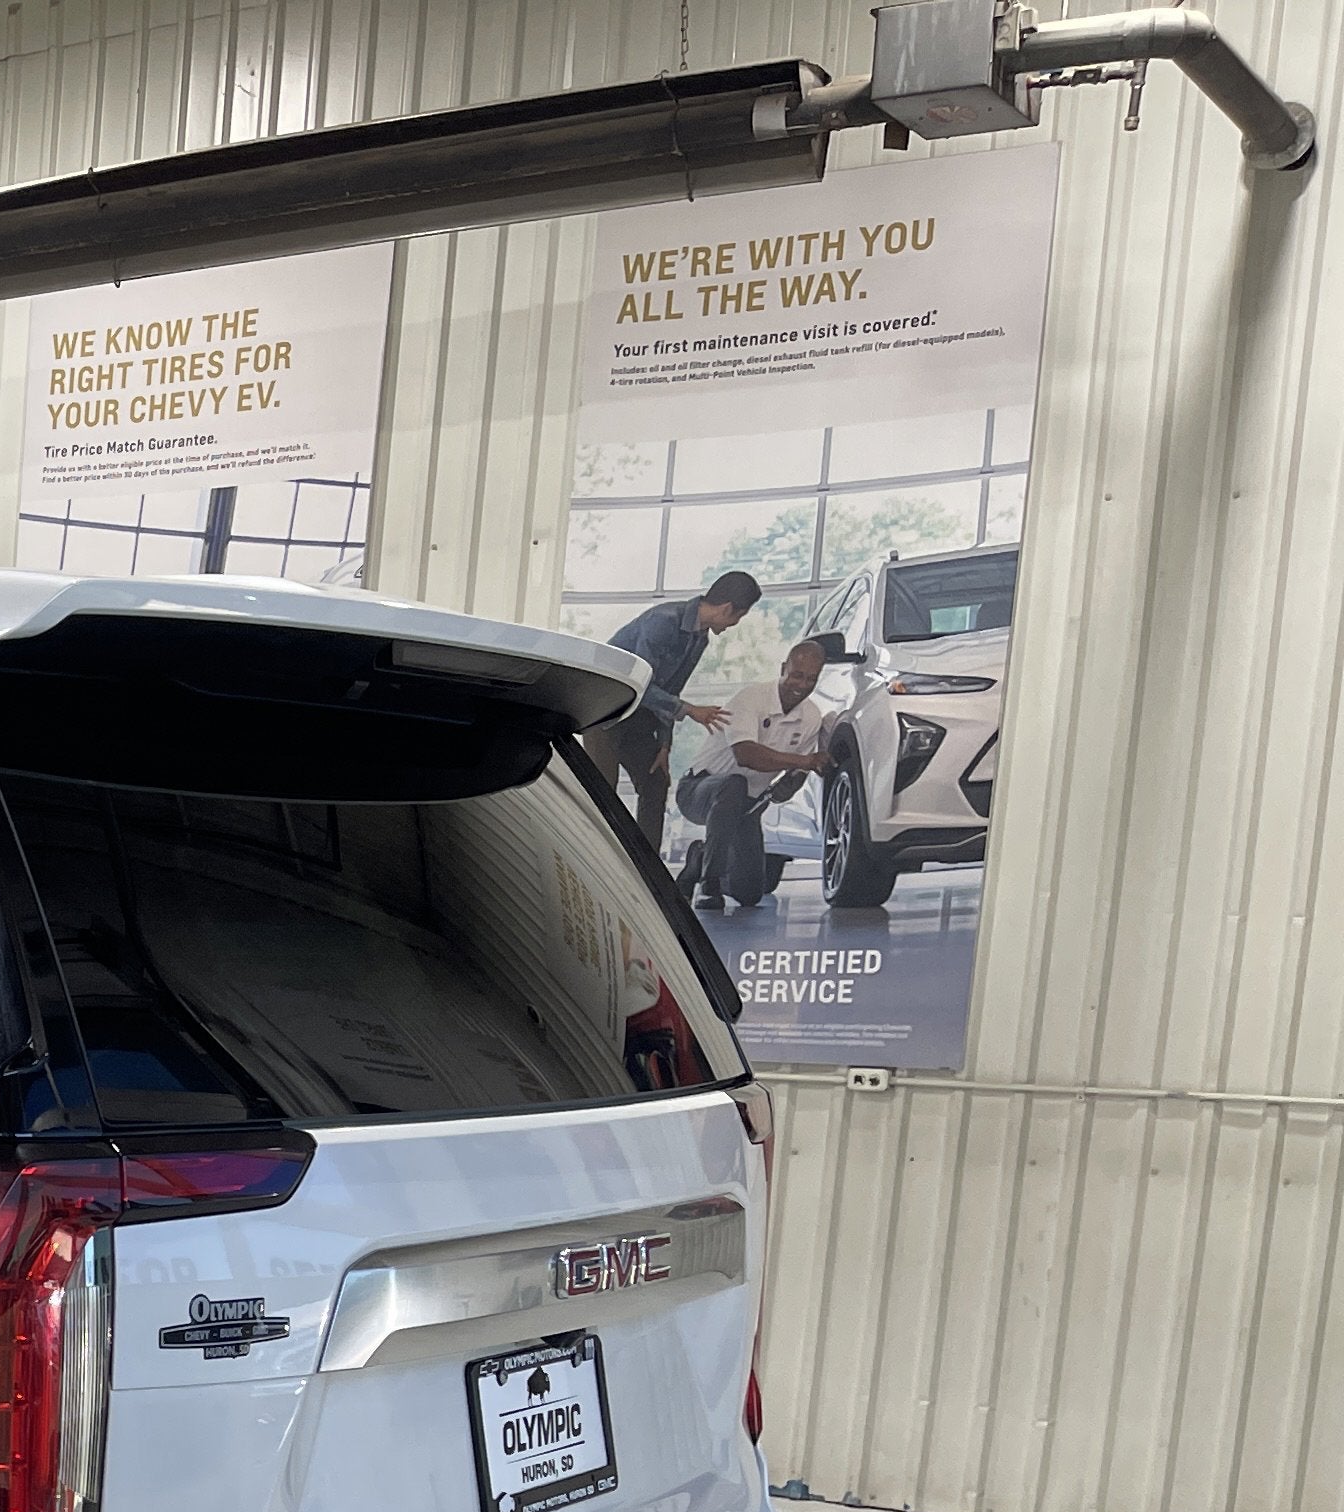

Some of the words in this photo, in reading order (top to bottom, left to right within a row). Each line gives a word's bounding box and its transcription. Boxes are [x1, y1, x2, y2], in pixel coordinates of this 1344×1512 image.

[623, 242, 736, 284] WE'RE
[748, 229, 845, 271] WITH
[859, 217, 936, 257] YOU
[616, 290, 684, 325] ALL
[696, 280, 767, 317] THE
[779, 268, 868, 308] WAY.
[53, 330, 96, 360] WE
[105, 318, 193, 355] KNOW
[202, 308, 259, 342] THE
[614, 343, 649, 358] Your
[653, 339, 688, 355] first
[693, 330, 798, 352] maintenance
[803, 323, 839, 340] visit
[843, 321, 857, 336] is
[49, 361, 134, 395] RIGHT
[142, 350, 224, 385] TIRES
[234, 341, 292, 375] FOR
[611, 366, 648, 375] Includes:
[649, 364, 660, 373] oil
[661, 363, 676, 372] and
[677, 362, 688, 370] oil
[689, 360, 710, 369] filter
[712, 358, 745, 368] change,
[746, 354, 772, 364] diesel
[773, 351, 806, 361] exhaust
[809, 348, 829, 358] fluid
[830, 345, 850, 355] tank
[893, 331, 965, 348] diesel-equipped
[671, 373, 687, 382] and
[688, 370, 735, 381] Multi-Point
[736, 366, 767, 376] Vehicle
[48, 399, 119, 430] YOUR
[129, 386, 228, 423] CHEVY
[236, 380, 280, 411] EV.
[44, 445, 67, 458] Tire
[71, 442, 103, 456] Price
[106, 439, 144, 454] Match
[148, 434, 218, 450] Guarantee.
[78, 464, 92, 472] with
[98, 462, 119, 470] better
[145, 459, 162, 467] price
[186, 454, 201, 462] time
[202, 453, 209, 461] of
[246, 448, 259, 456] and
[278, 443, 301, 453] match
[84, 474, 101, 482] price
[102, 472, 123, 480] within
[133, 470, 149, 478] days
[237, 459, 262, 468] refund
[739, 950, 882, 975] CERTIFIED
[737, 979, 855, 1004] SERVICE
[557, 1232, 671, 1299] GMC
[190, 1295, 264, 1322] OLYMPIC
[502, 1403, 582, 1455] OLYMPIC
[521, 1458, 558, 1483] HURON,
[561, 1454, 574, 1472] SD
